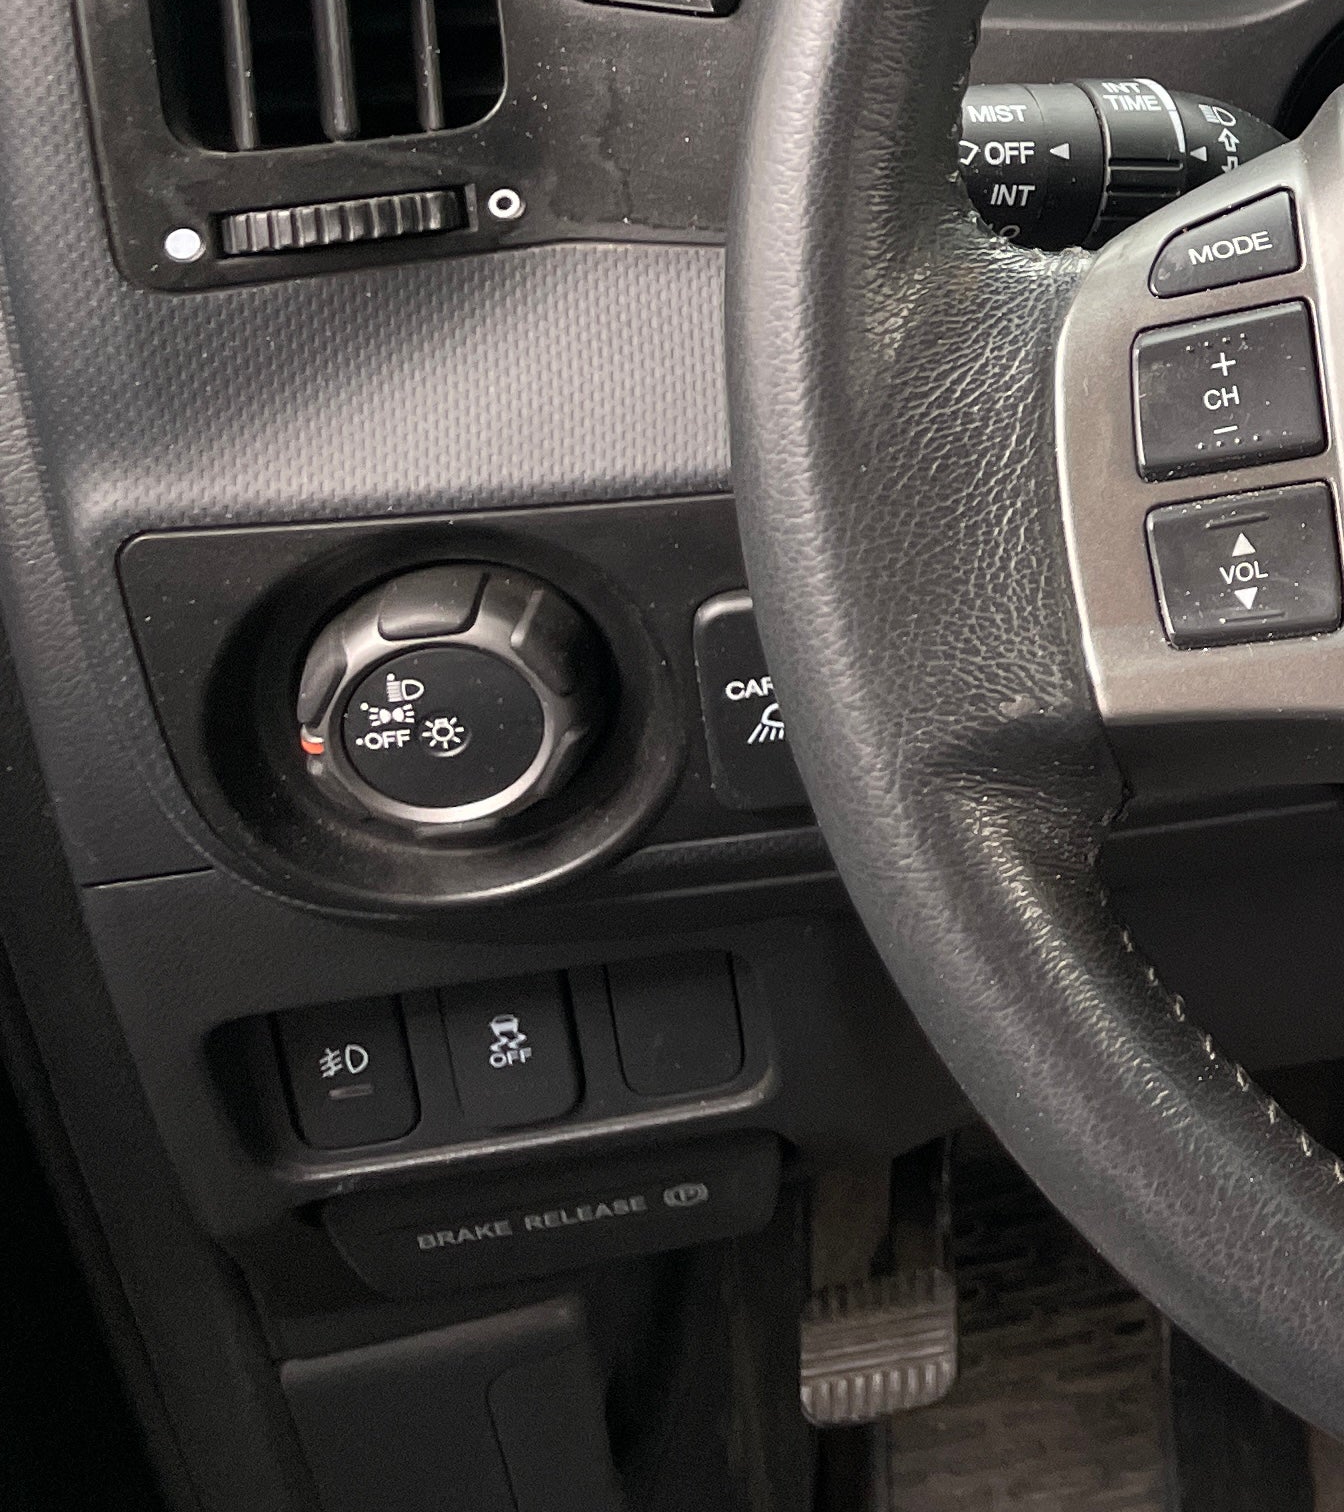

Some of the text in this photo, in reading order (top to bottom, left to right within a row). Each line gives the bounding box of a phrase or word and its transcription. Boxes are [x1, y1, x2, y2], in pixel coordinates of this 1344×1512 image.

[1101, 81, 1141, 94] INT
[967, 104, 1027, 124] MIST
[1102, 94, 1162, 112] TIME
[984, 141, 1036, 166] OFF
[990, 183, 1036, 207] INT
[1187, 230, 1274, 266] MODE
[1203, 385, 1240, 411] CH
[1219, 560, 1269, 584] VOL
[364, 728, 411, 750] OFF
[489, 1046, 533, 1069] OFF
[416, 1194, 648, 1251] BRAKE RELEASE
